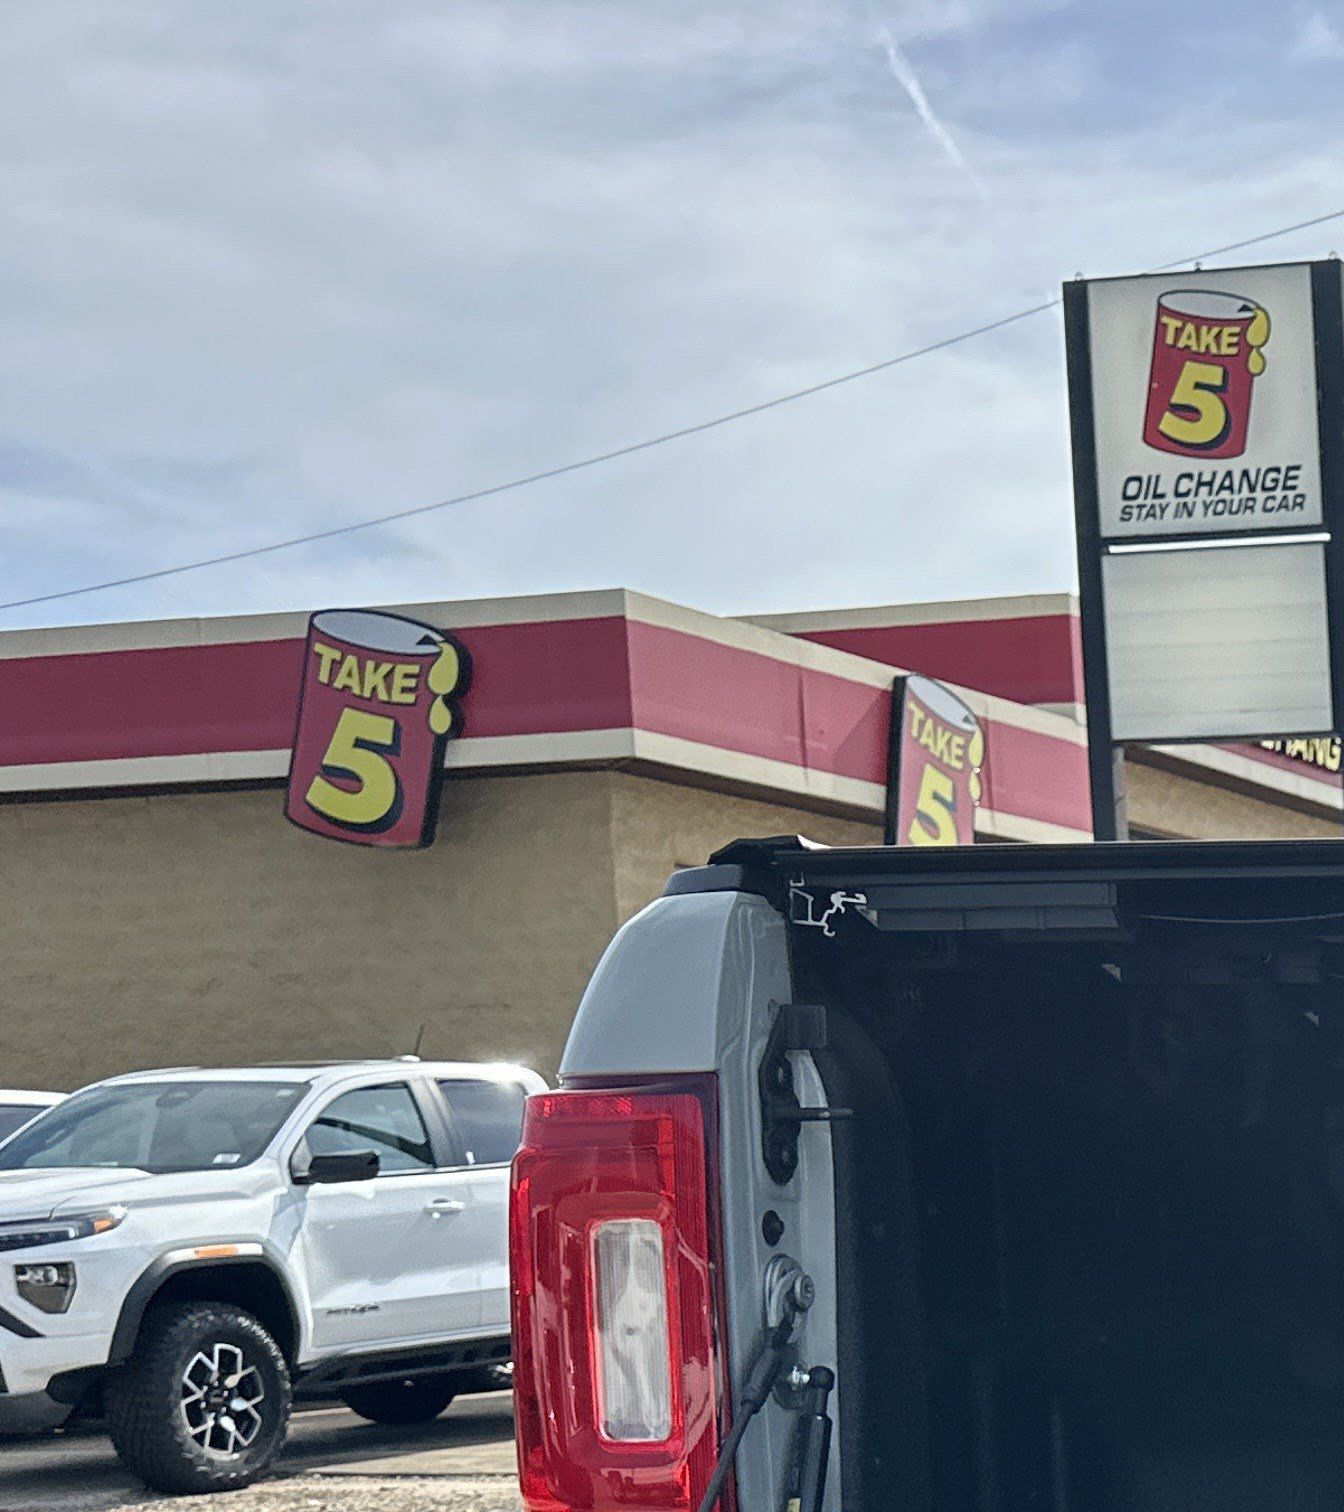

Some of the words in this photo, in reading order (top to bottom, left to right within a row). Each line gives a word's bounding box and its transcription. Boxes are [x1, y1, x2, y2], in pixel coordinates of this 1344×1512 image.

[1160, 315, 1241, 356] TAKE
[1158, 360, 1230, 447] 5
[1119, 502, 1170, 523] STAY
[1173, 502, 1198, 520] IN
[1203, 497, 1258, 518] YOUR
[1261, 493, 1307, 514] CAR
[1121, 473, 1167, 501] OIL
[1174, 464, 1303, 498] CHANGE
[313, 641, 422, 705] TAKE
[305, 706, 401, 828] 5
[908, 700, 966, 771] TAKE
[908, 762, 958, 846] 5
